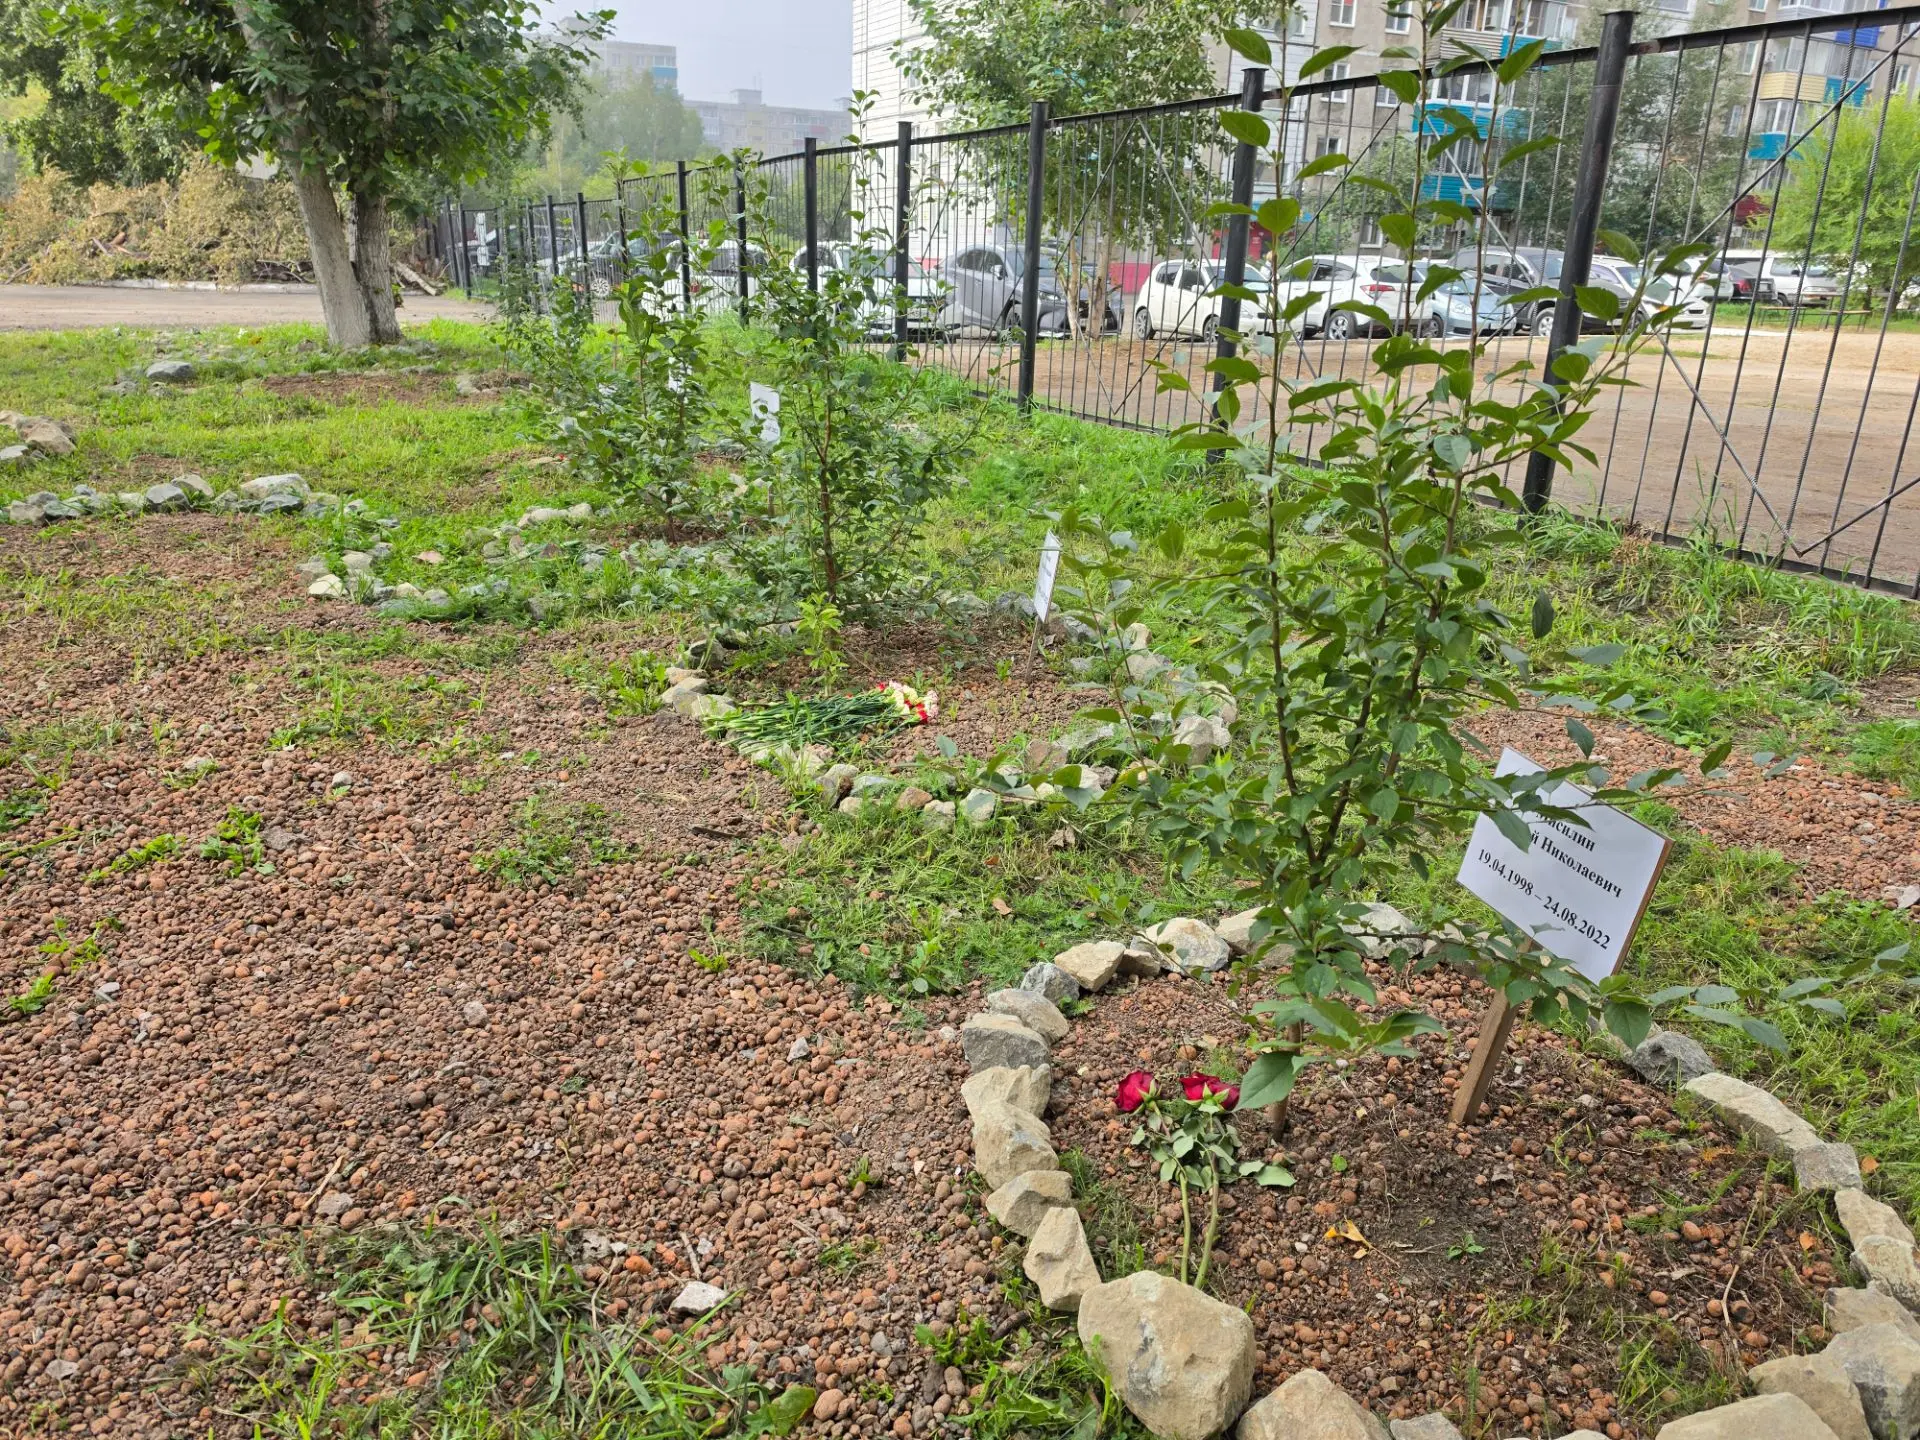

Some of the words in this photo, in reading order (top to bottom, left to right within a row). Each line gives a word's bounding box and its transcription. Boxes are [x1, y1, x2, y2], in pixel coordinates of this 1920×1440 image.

[1478, 849, 1534, 896] 19.04.1998
[1543, 896, 1611, 950] 24.08.2022
[1541, 836, 1623, 898] Николаевич
